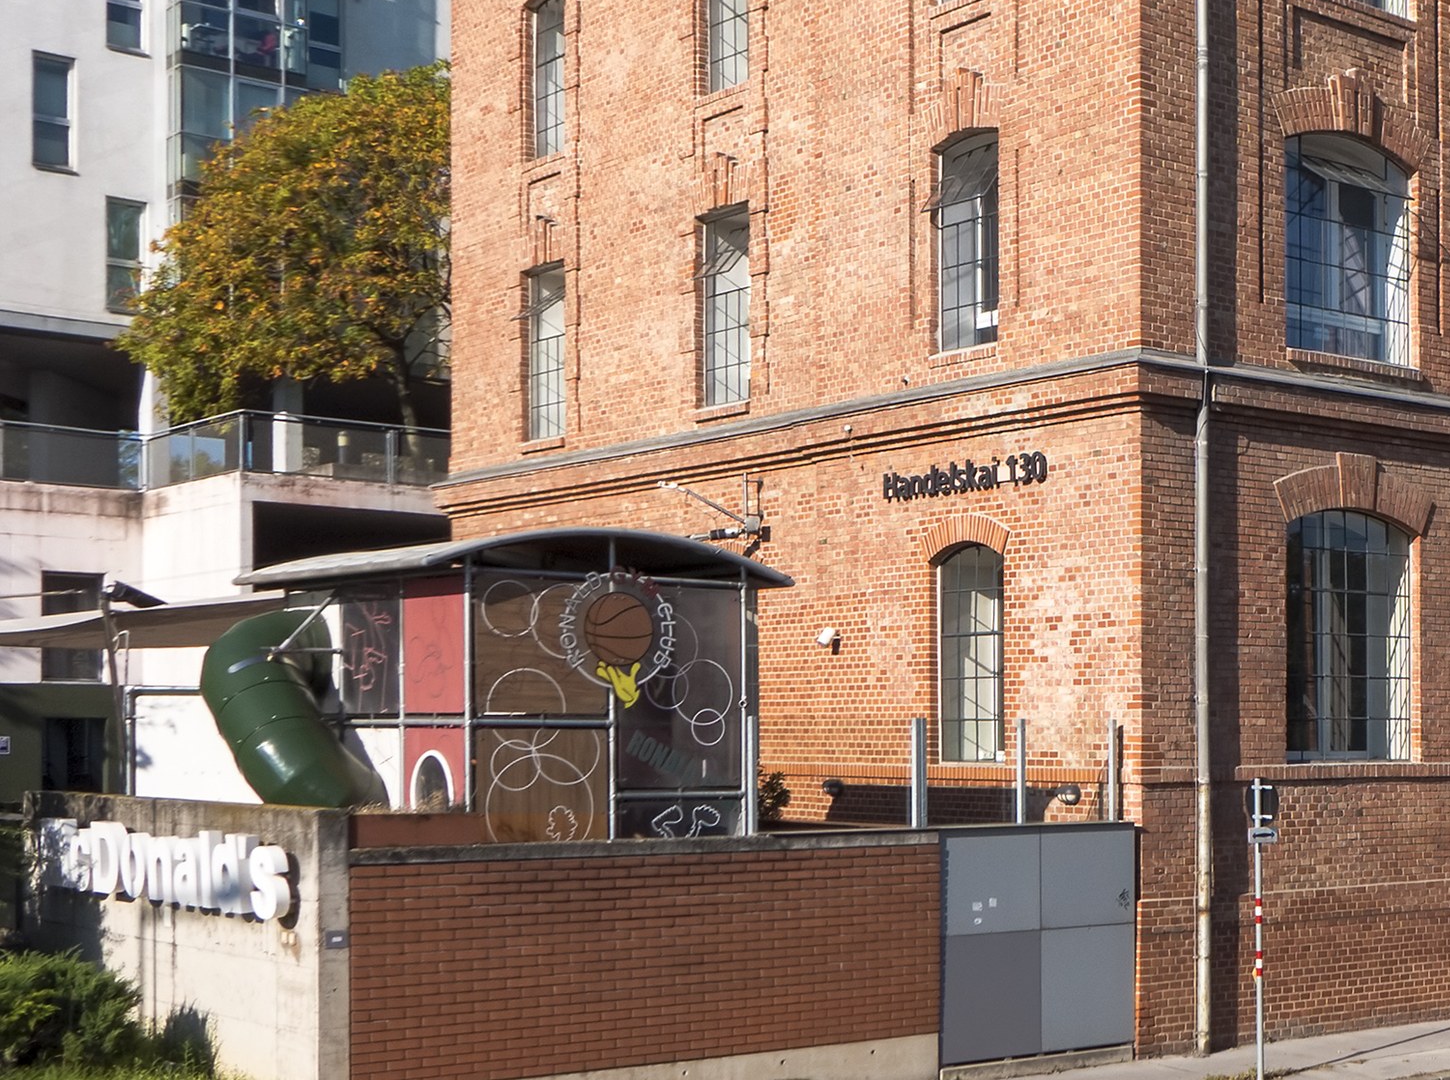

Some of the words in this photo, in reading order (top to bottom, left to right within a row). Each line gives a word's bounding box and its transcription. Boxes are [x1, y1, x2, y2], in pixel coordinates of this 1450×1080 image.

[883, 456, 1000, 503] Handelskai
[1005, 451, 1048, 486] 130
[558, 570, 602, 669] RONALD
[653, 602, 677, 669] CLUB
